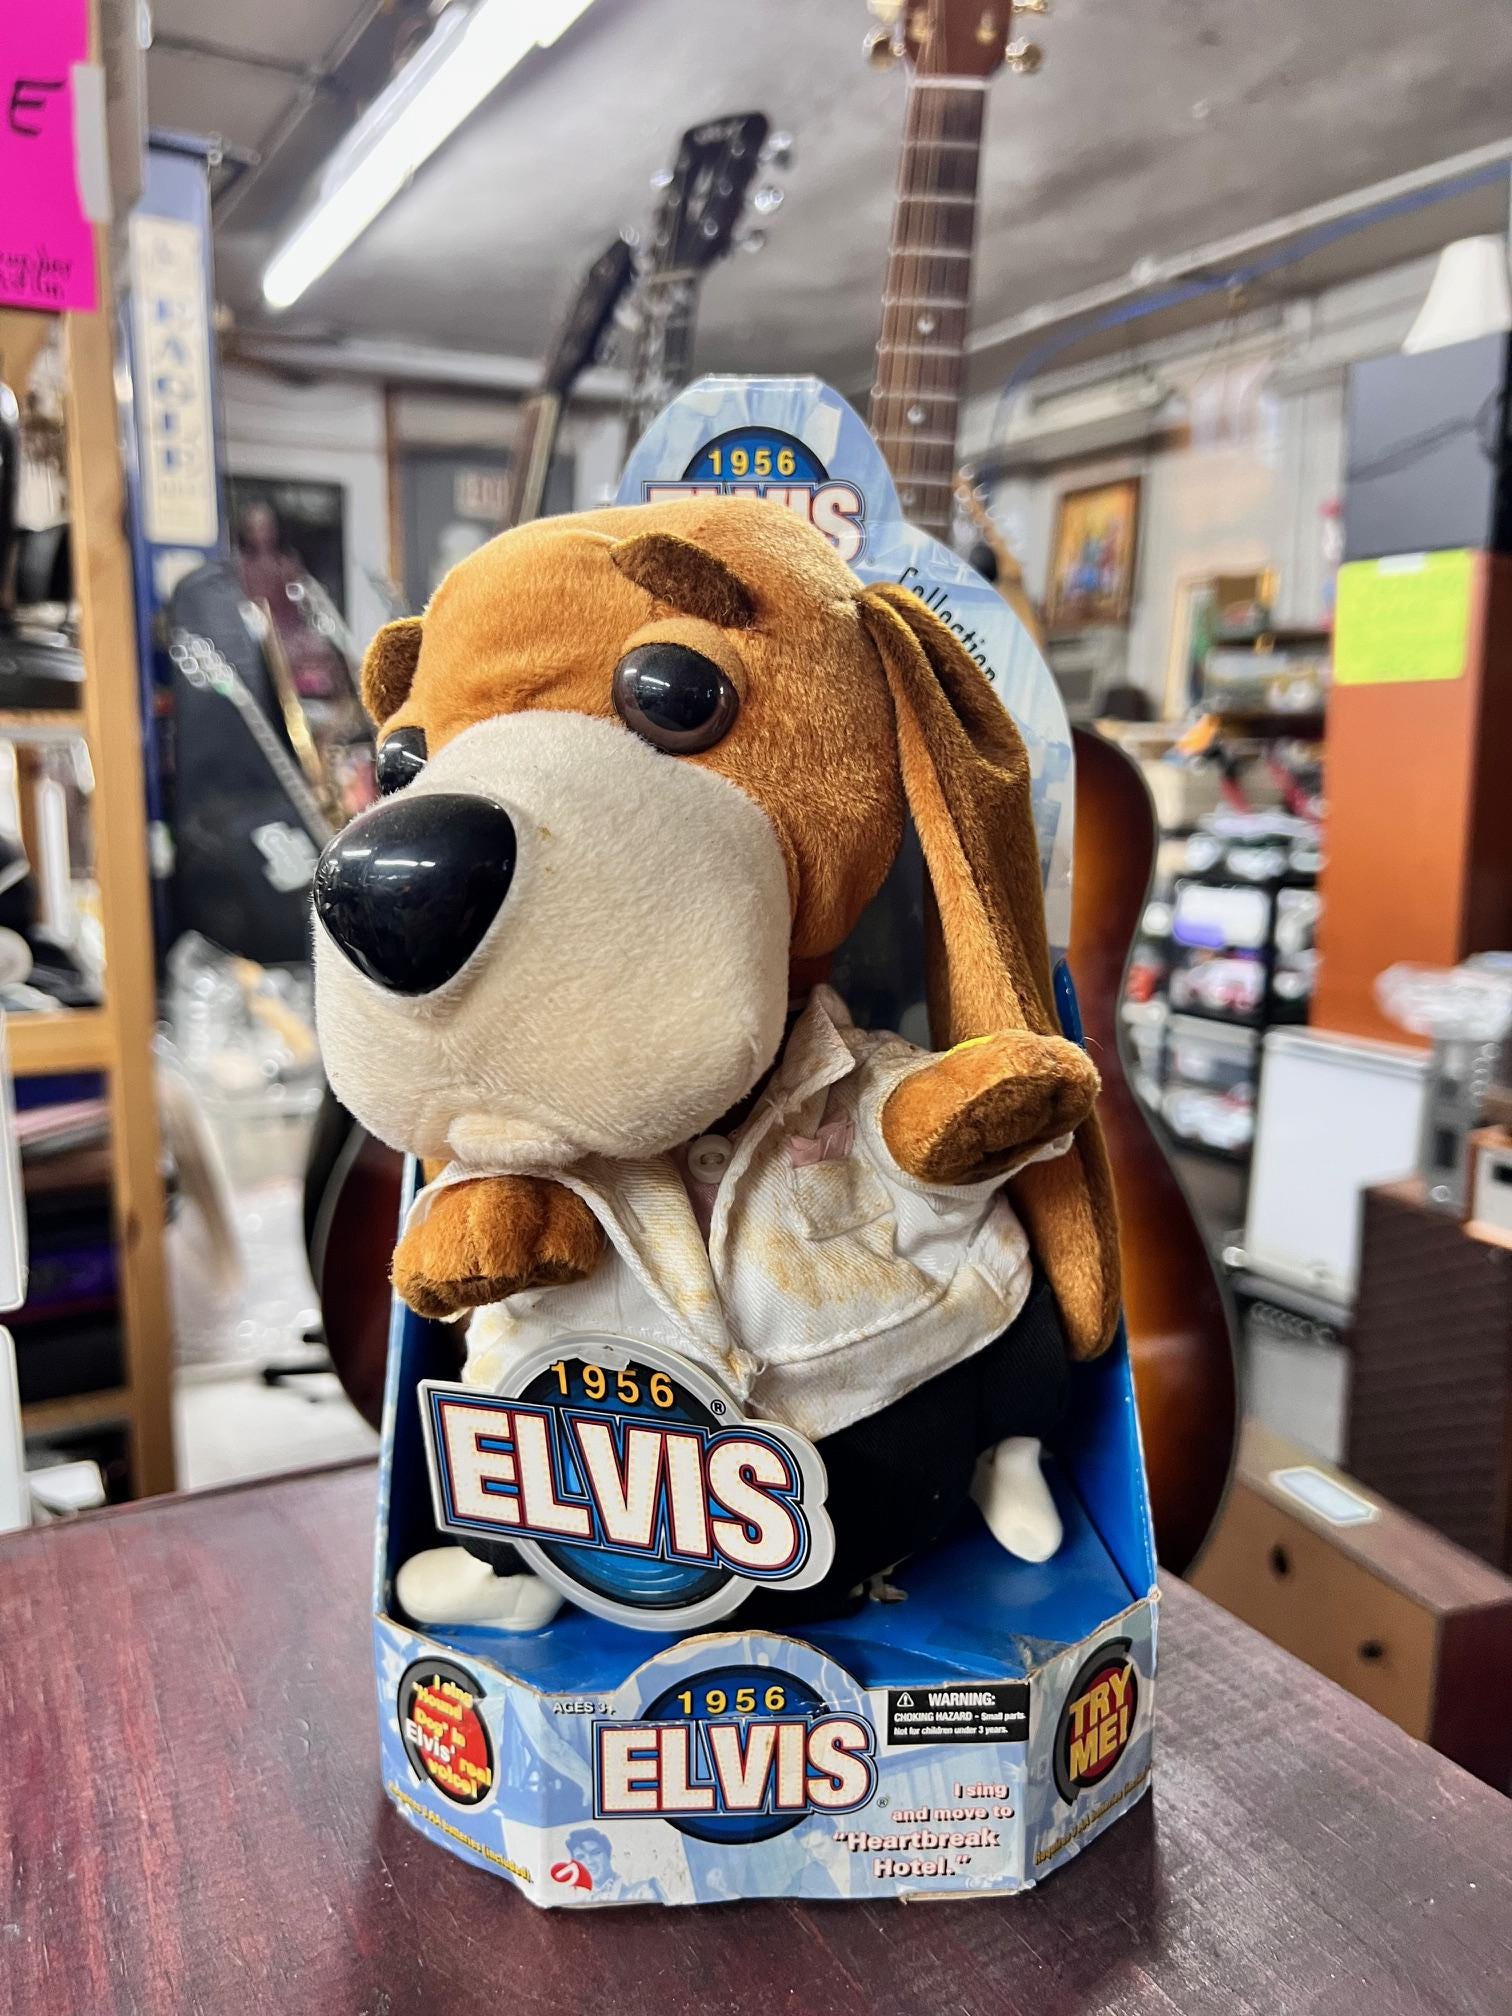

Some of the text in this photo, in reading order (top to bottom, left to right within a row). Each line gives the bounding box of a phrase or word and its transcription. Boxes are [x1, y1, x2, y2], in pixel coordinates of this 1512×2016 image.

[708, 448, 796, 477] 1956
[551, 1360, 674, 1409] 1956
[439, 1402, 799, 1570] ELVIS
[553, 1701, 595, 1714] AGES
[678, 1686, 786, 1714] 1956
[928, 1692, 996, 1707] WARNING:
[1069, 1664, 1133, 1739] TRY
[921, 1726, 953, 1735] children
[954, 1726, 977, 1735] under
[978, 1726, 984, 1734] 3
[935, 1711, 973, 1722] HAZARD
[981, 1712, 1003, 1721] Small
[1069, 1705, 1128, 1781] ME!
[600, 1718, 870, 1812] ELVIS
[954, 1782, 1010, 1799] I sing
[892, 1805, 1015, 1823] and move to
